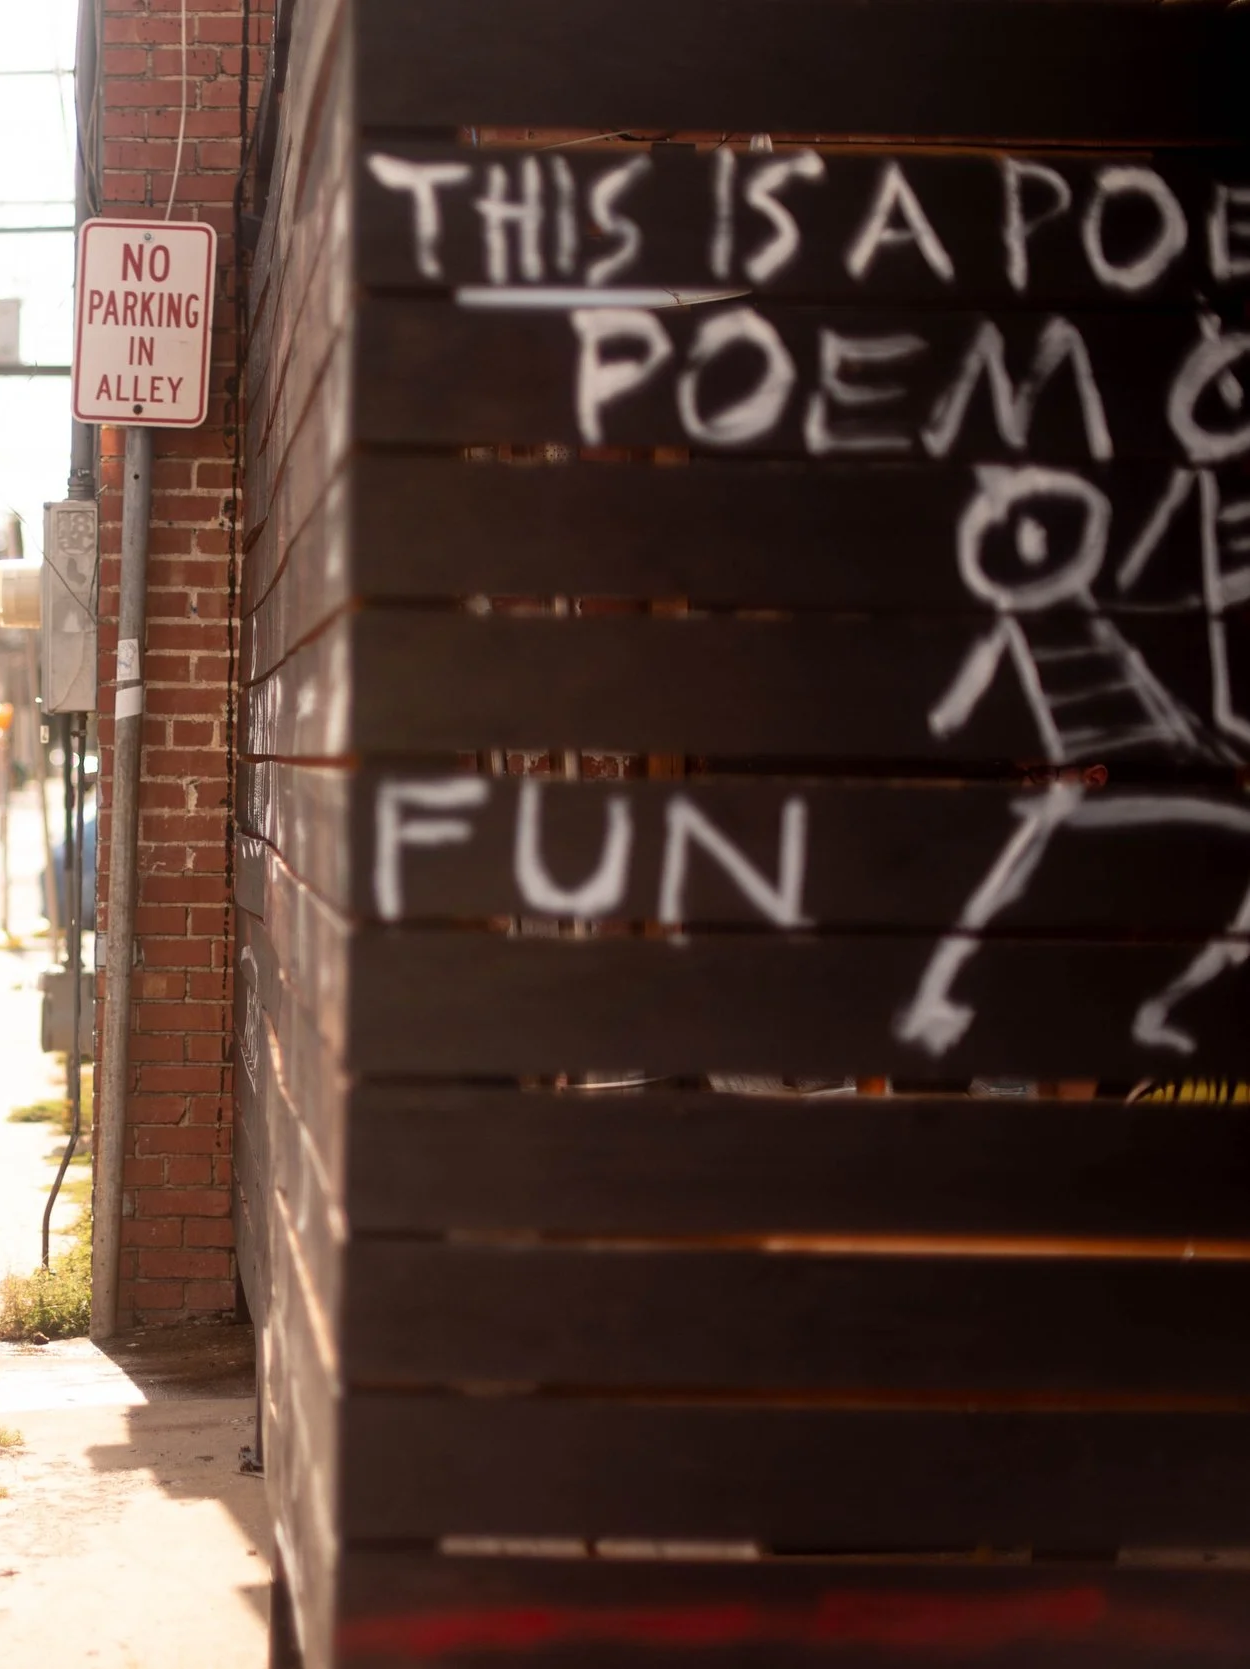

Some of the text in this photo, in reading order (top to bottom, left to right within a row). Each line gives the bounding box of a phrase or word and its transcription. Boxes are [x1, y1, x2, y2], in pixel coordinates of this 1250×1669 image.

[365, 150, 654, 288] THIS
[710, 148, 828, 283] IS
[845, 161, 956, 280] A
[121, 243, 171, 282] NO
[87, 289, 200, 329] PARKING
[128, 336, 155, 366] IN
[95, 374, 184, 404] ALLEY
[566, 306, 1116, 464] POEM
[371, 772, 810, 928] FUN
